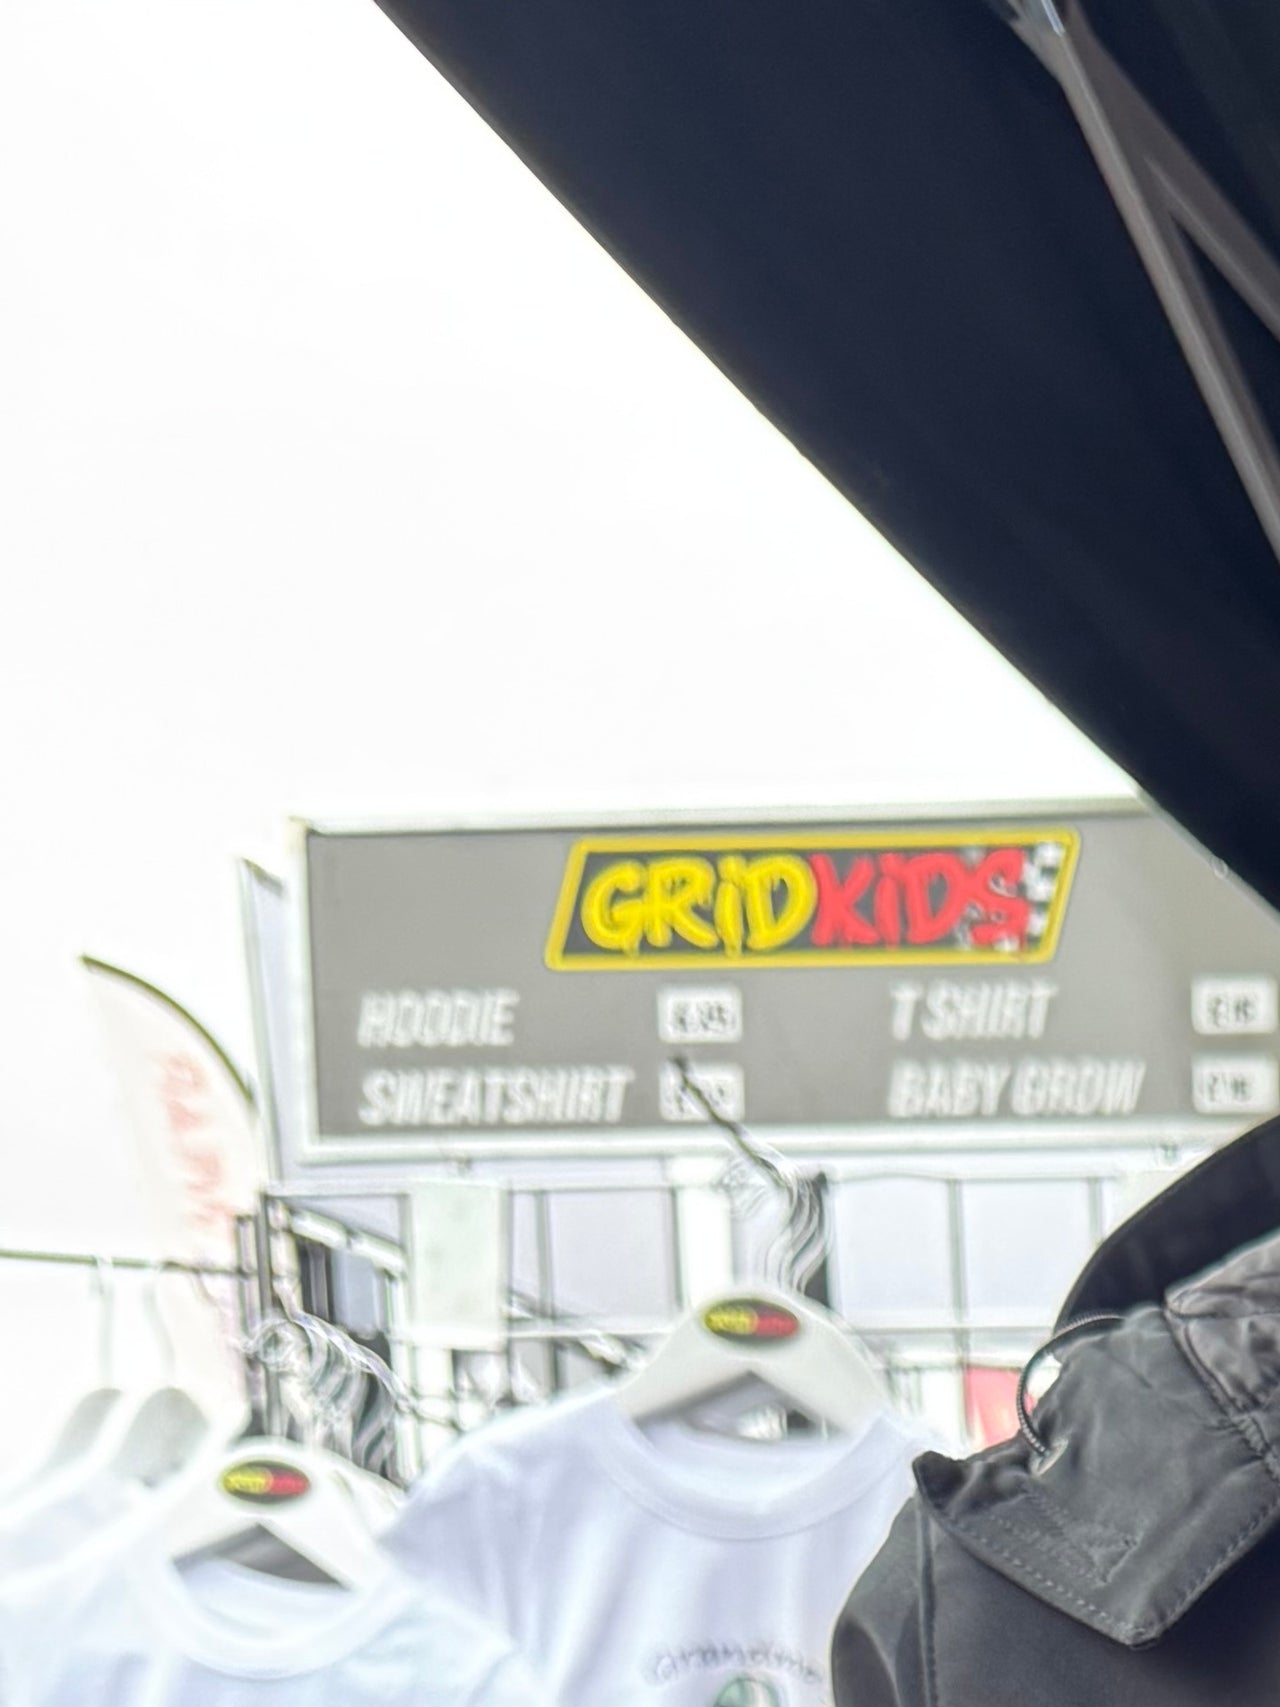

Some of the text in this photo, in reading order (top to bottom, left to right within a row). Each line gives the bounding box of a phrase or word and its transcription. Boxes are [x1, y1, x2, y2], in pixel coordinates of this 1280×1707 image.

[357, 988, 519, 1047] HOODIE
[891, 975, 1057, 1042] T SHIRT
[359, 1063, 634, 1126] SWEATSHIRT
[888, 1058, 1009, 1119] BABY
[1011, 1055, 1146, 1117] GROW
